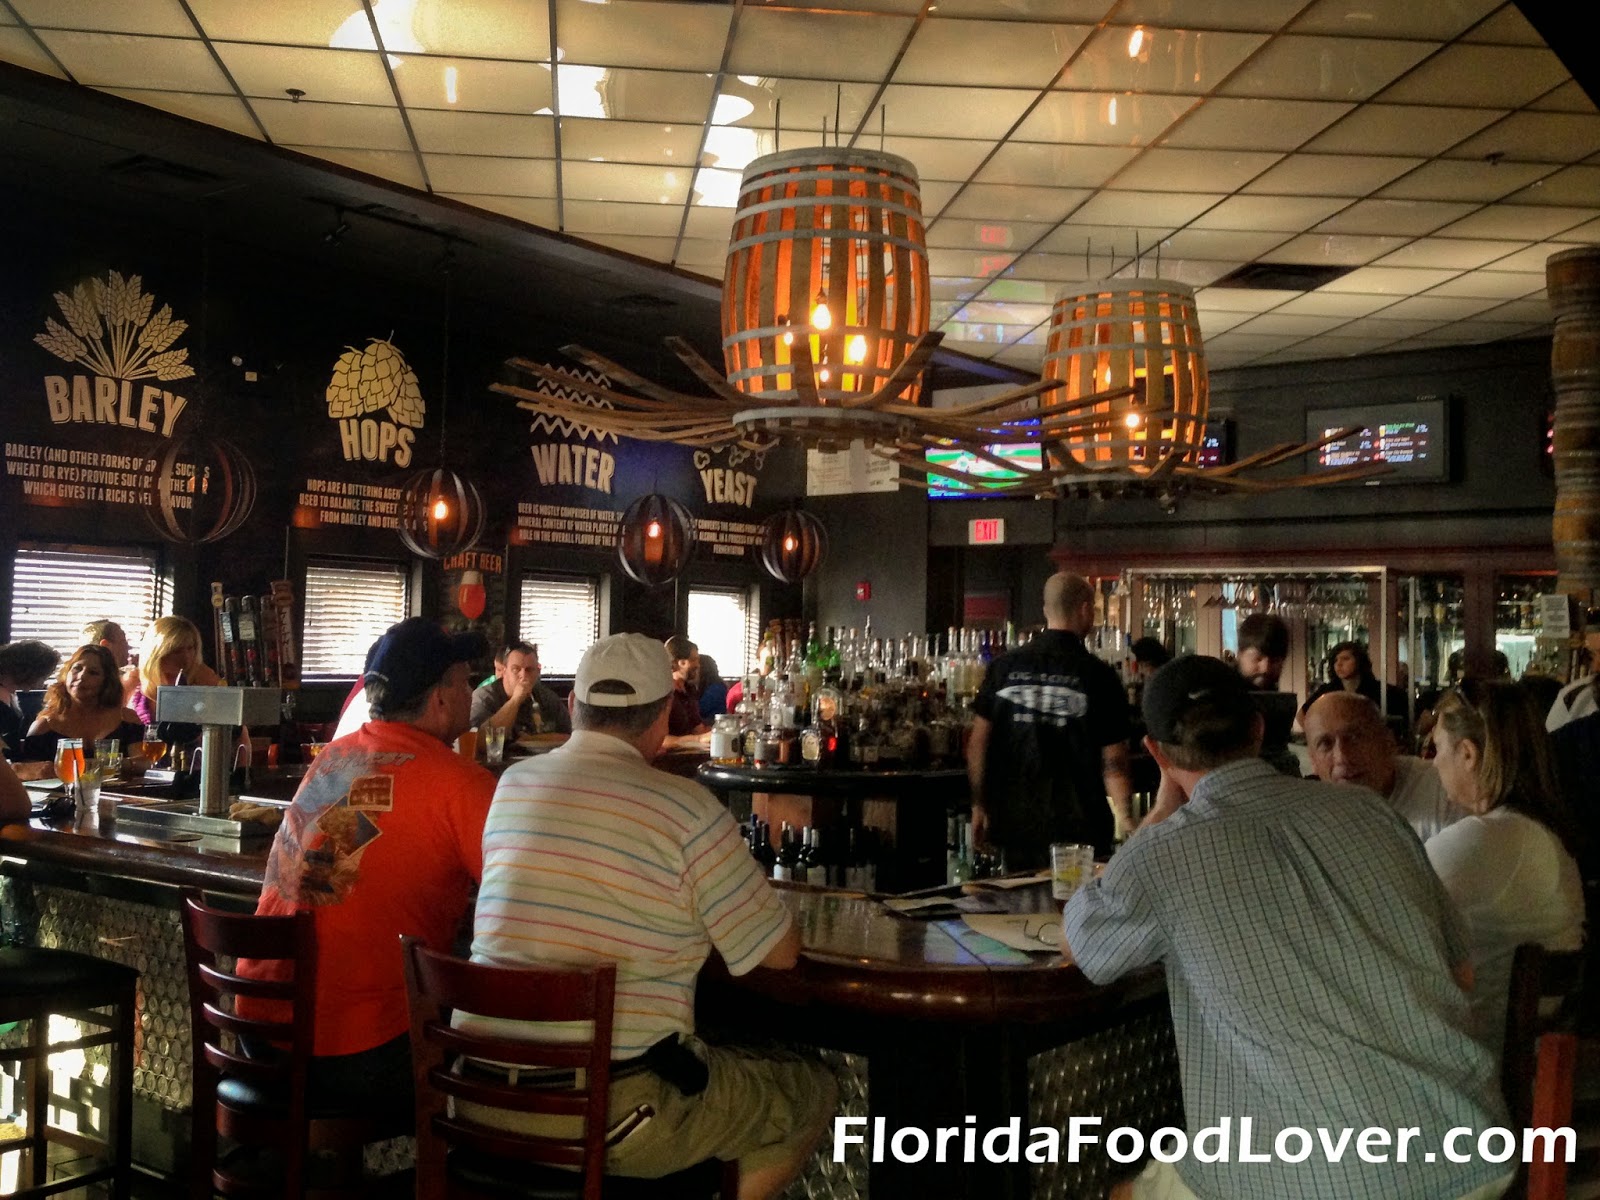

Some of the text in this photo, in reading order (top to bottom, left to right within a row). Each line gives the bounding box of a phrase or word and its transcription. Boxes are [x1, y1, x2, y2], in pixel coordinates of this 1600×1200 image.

[44, 374, 188, 438] BARLEY
[339, 418, 416, 468] HOPS
[5, 443, 42, 459] BARLEY
[44, 446, 68, 463] (AND
[70, 450, 99, 466] OTHER
[100, 454, 131, 470] FORMS
[6, 461, 40, 478] WHEAT
[42, 465, 55, 479] OR
[57, 466, 79, 482] RYE)
[81, 468, 119, 486] PROVIDE
[531, 443, 616, 495] WATER
[23, 480, 56, 497] WHICH
[58, 483, 85, 499] GIVES
[87, 486, 96, 500] IT
[98, 487, 104, 501] A
[105, 489, 127, 503] RICH
[307, 479, 326, 493] HOPS
[327, 481, 341, 494] ARE
[341, 483, 347, 494] A
[348, 484, 382, 498] BITTERING
[700, 468, 758, 508] YEAST
[300, 493, 319, 507] USED
[320, 496, 328, 508] TO
[329, 497, 360, 511] BALANCE
[361, 500, 374, 513] THE
[533, 504, 539, 516] IS
[320, 511, 340, 524] FROM
[341, 513, 367, 526] BARLEY
[368, 515, 381, 528] AND
[975, 519, 998, 541] EXIT
[443, 551, 502, 574] CRAFT BEER
